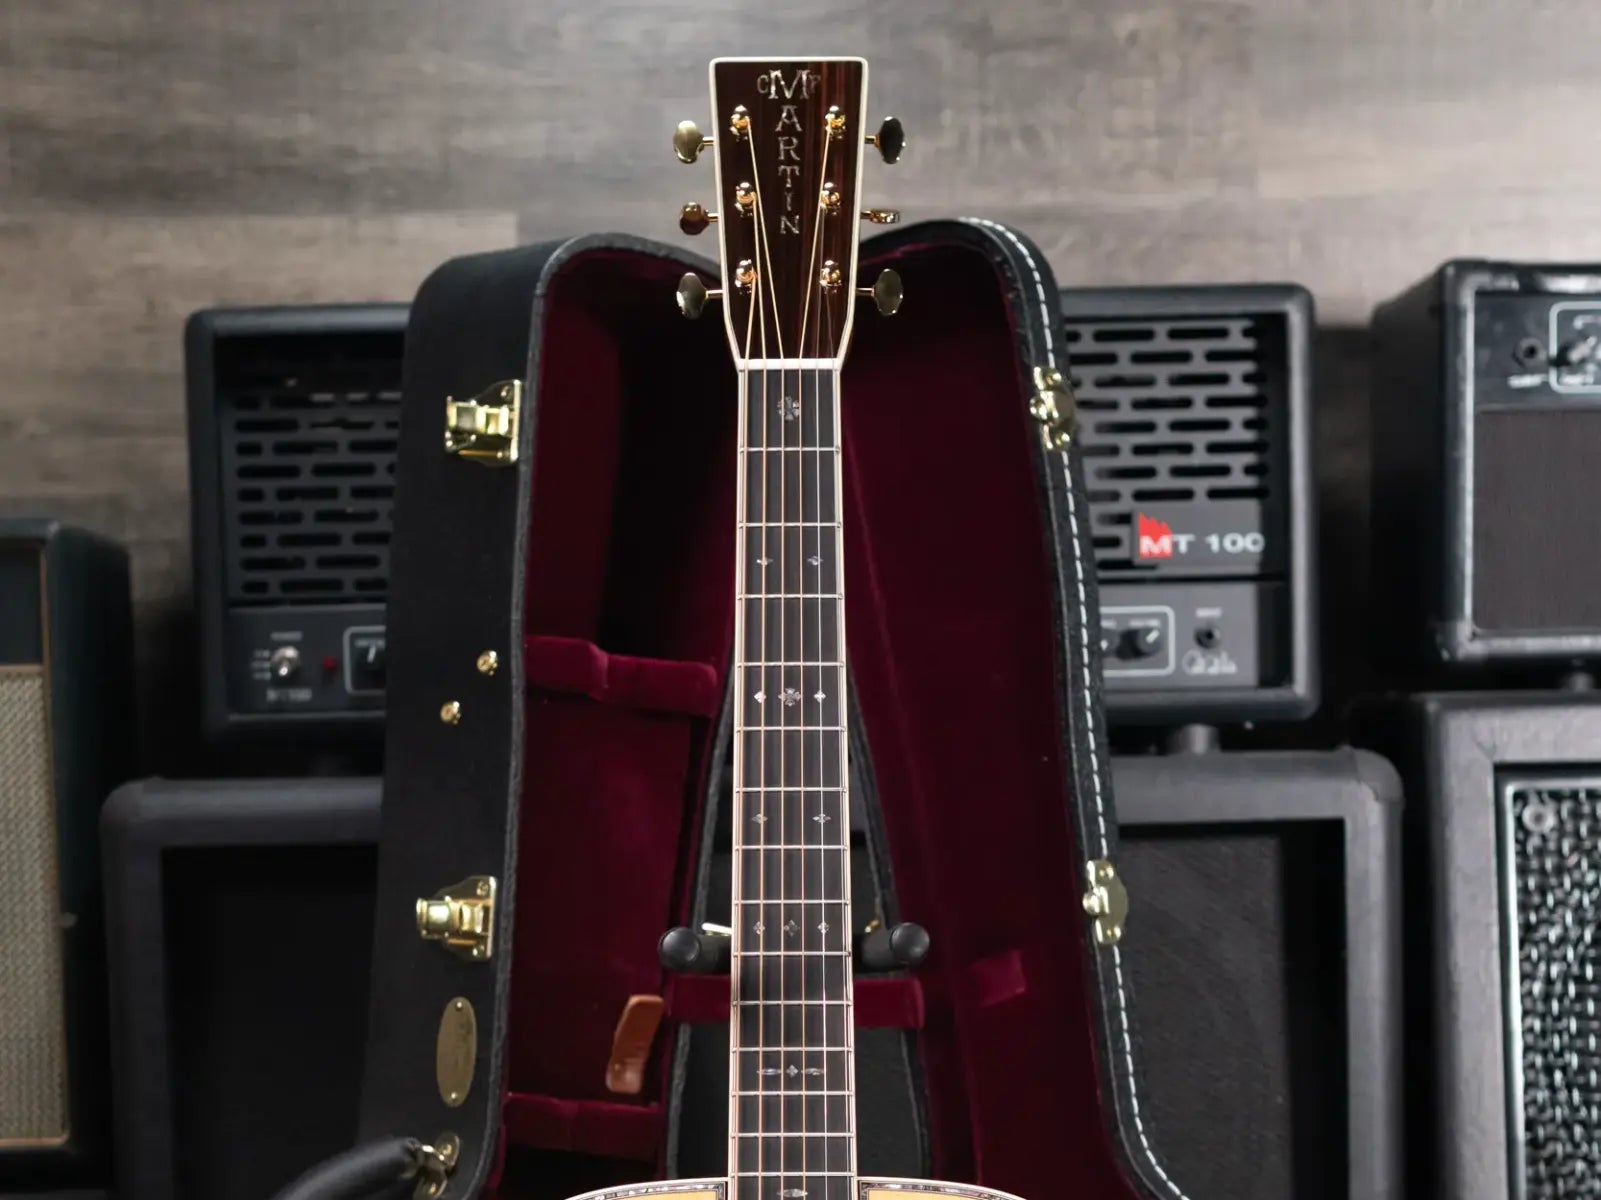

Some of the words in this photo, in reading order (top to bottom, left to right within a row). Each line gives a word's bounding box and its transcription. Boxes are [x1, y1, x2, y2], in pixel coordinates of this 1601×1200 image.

[768, 69, 811, 235] MARTIN
[1139, 534, 1195, 554] MT
[1206, 532, 1265, 553] 100
